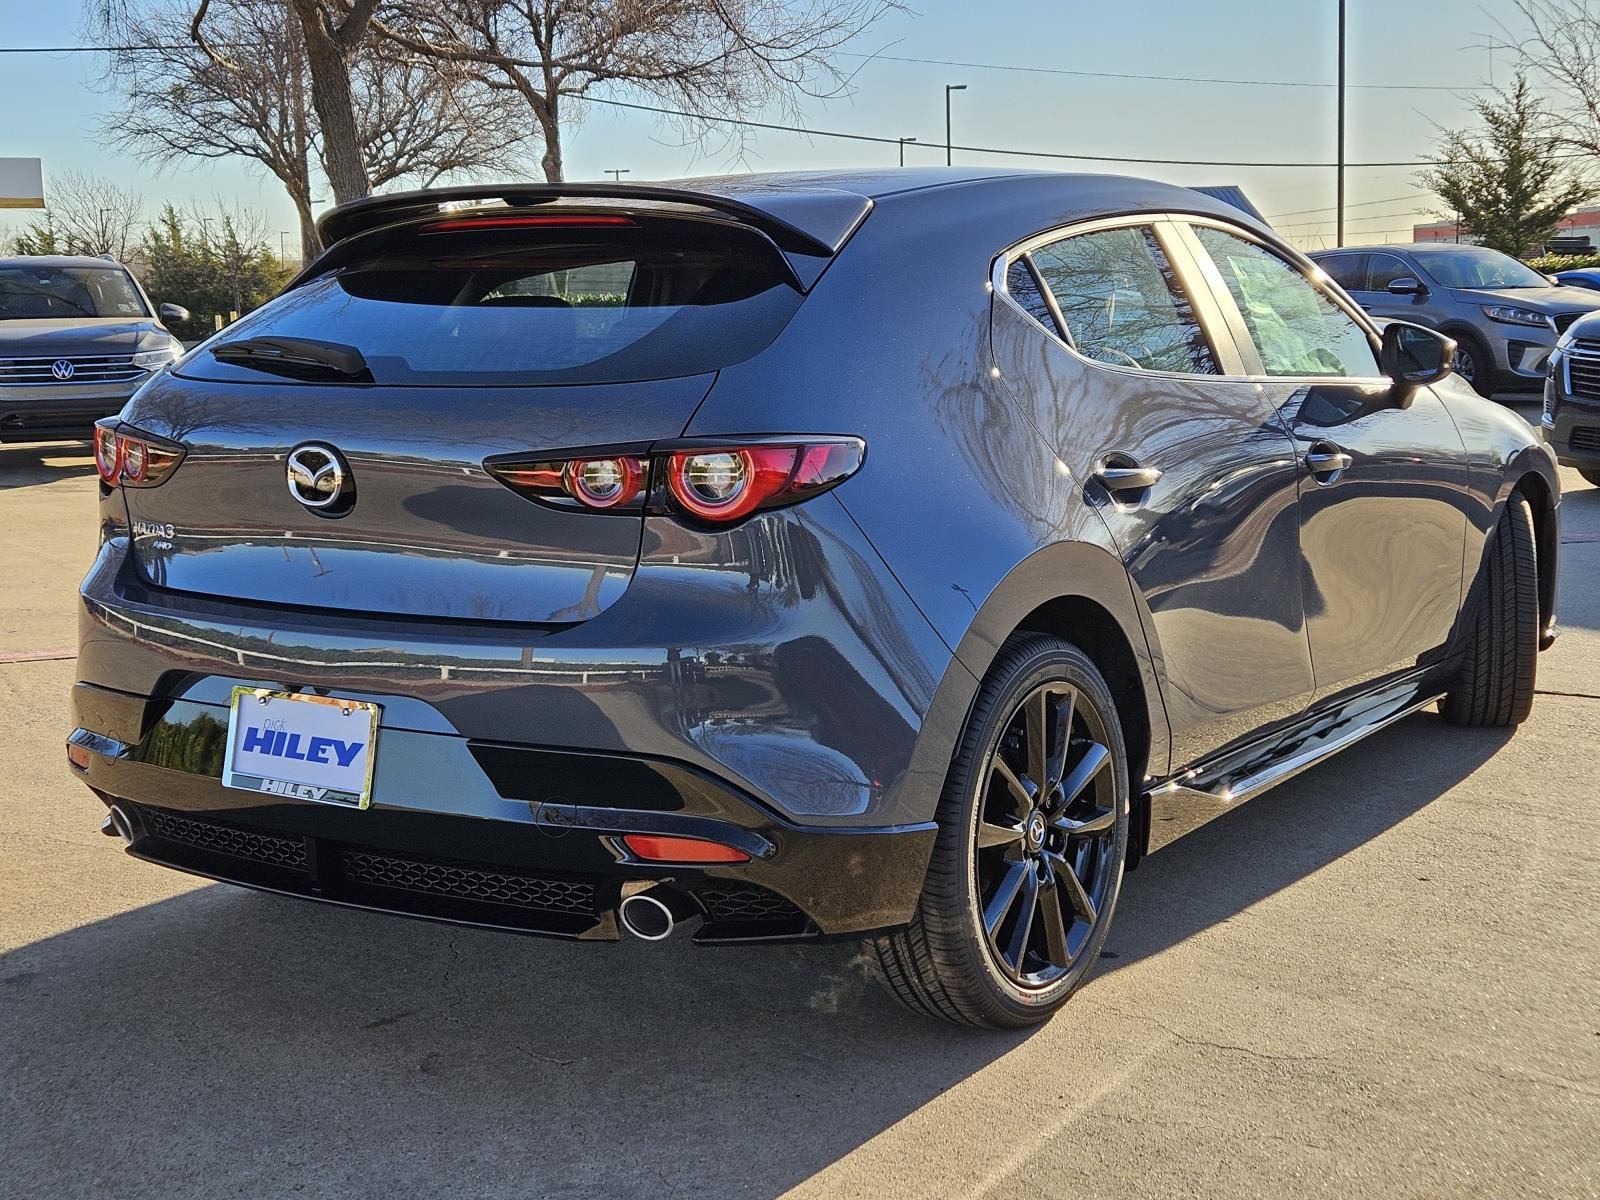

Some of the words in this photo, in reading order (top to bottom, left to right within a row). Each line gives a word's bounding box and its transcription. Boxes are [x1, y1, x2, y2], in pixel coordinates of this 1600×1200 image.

[262, 717, 287, 731] pick
[242, 727, 364, 767] HILEY
[260, 779, 328, 800] HILEY
